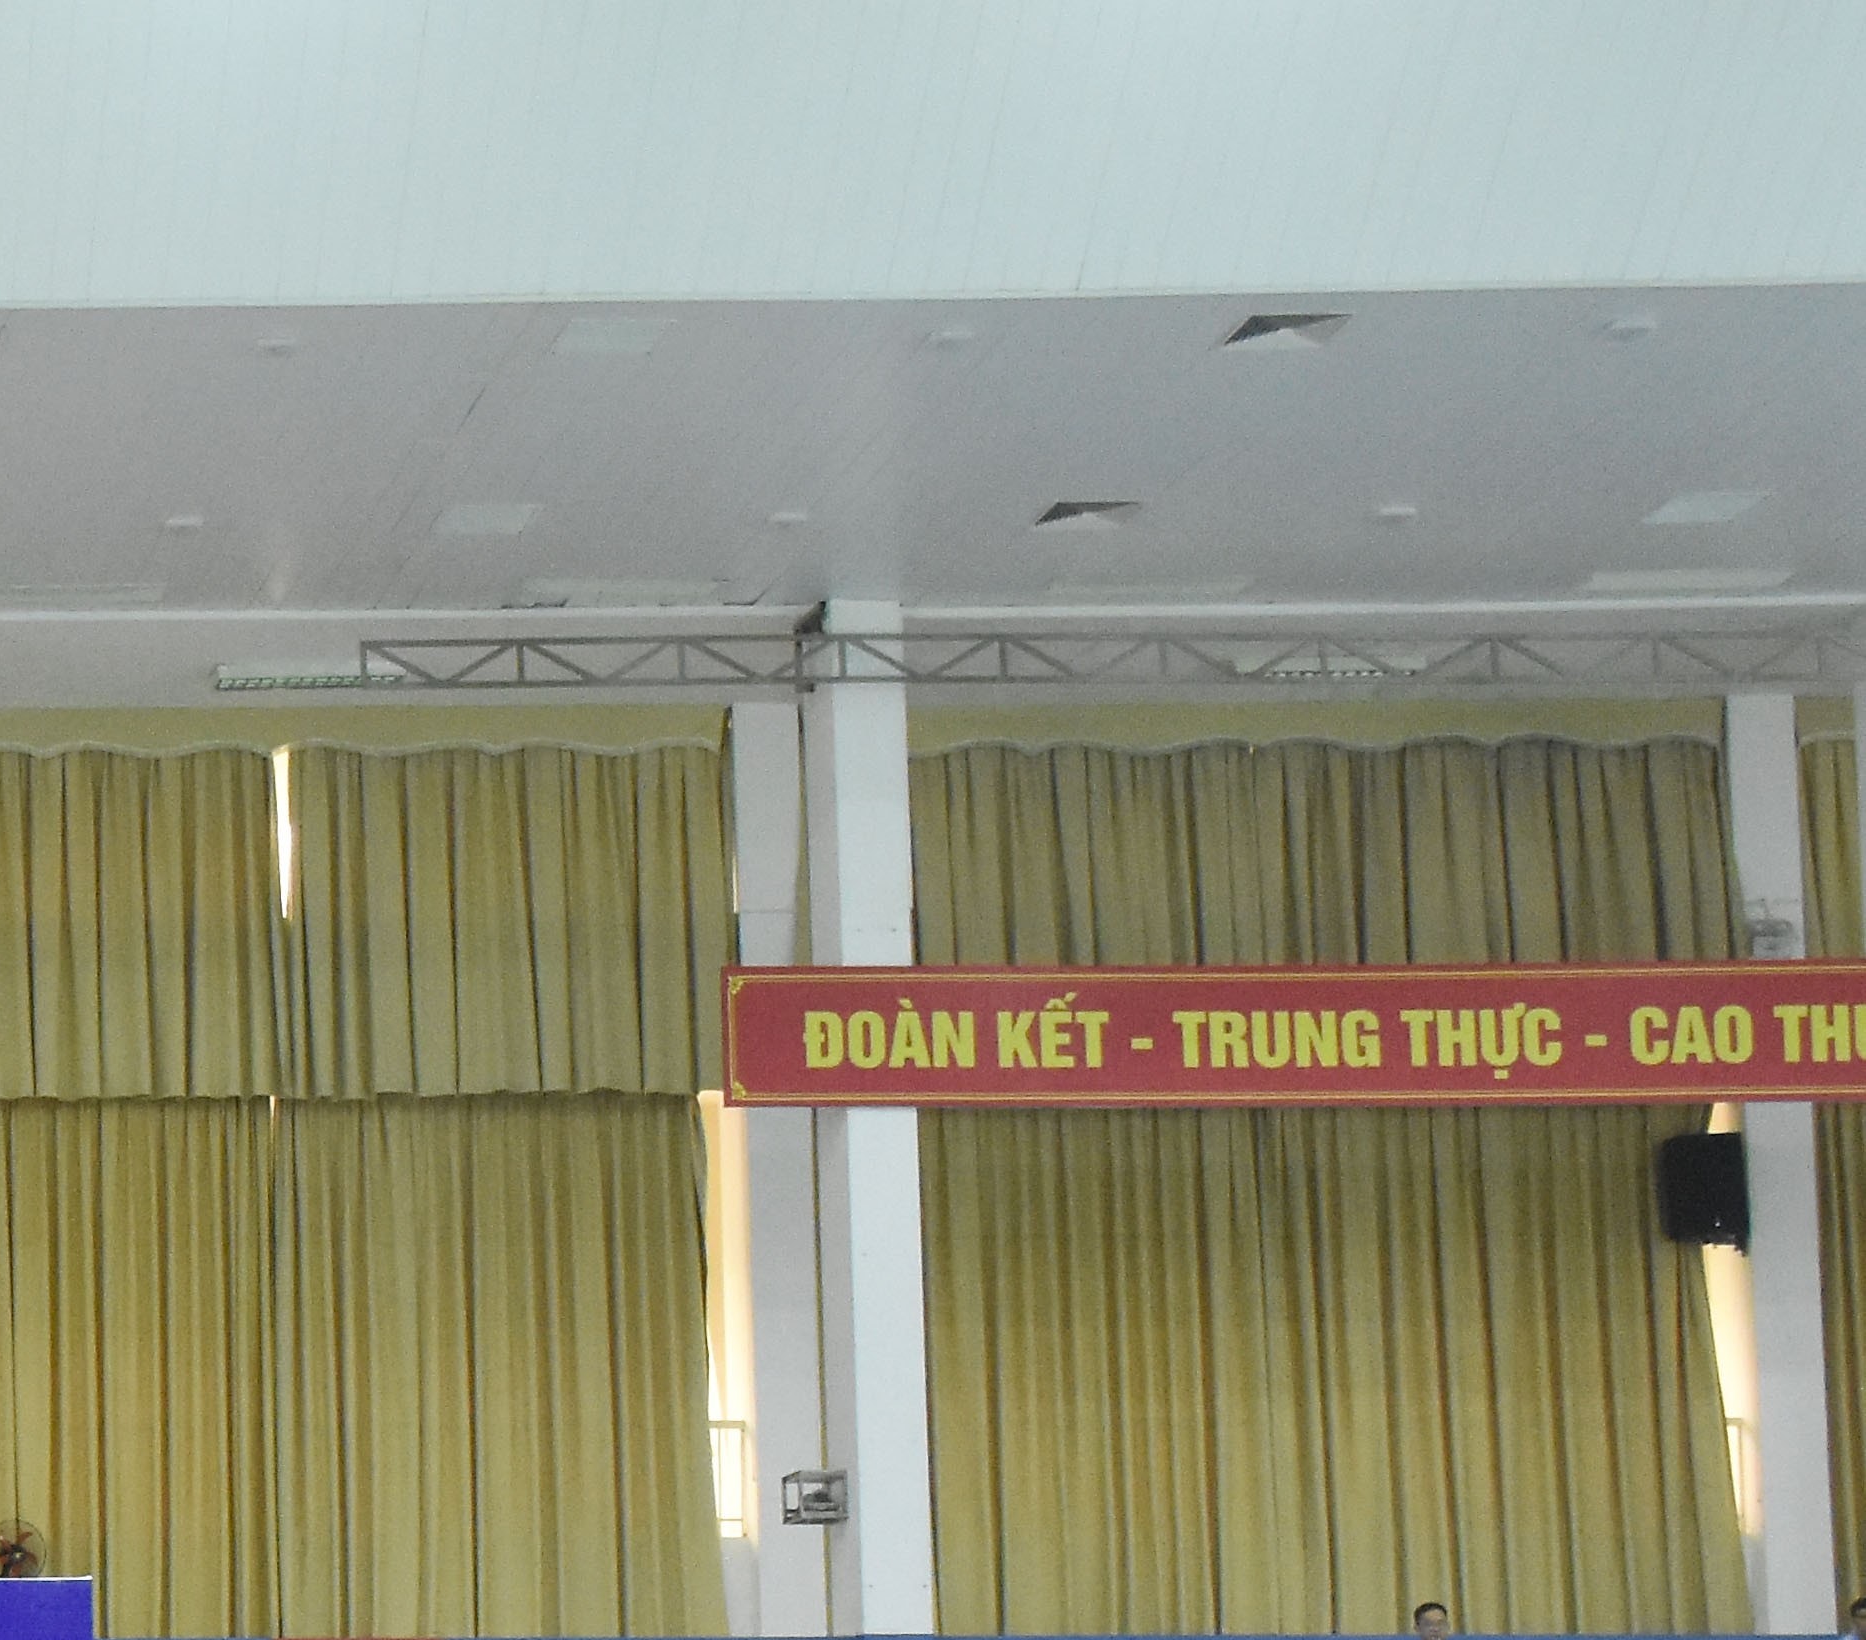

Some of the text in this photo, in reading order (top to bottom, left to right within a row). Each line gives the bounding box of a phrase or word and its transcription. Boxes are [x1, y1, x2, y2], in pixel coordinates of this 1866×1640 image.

[804, 998, 976, 1069] ĐOÀN
[997, 991, 1110, 1068] KẾT
[1132, 1037, 1153, 1050] -
[1172, 1009, 1381, 1069] TRUNG
[1400, 1002, 1563, 1080] THỰC
[1585, 1034, 1607, 1047] -
[1630, 1005, 1753, 1065] CAO
